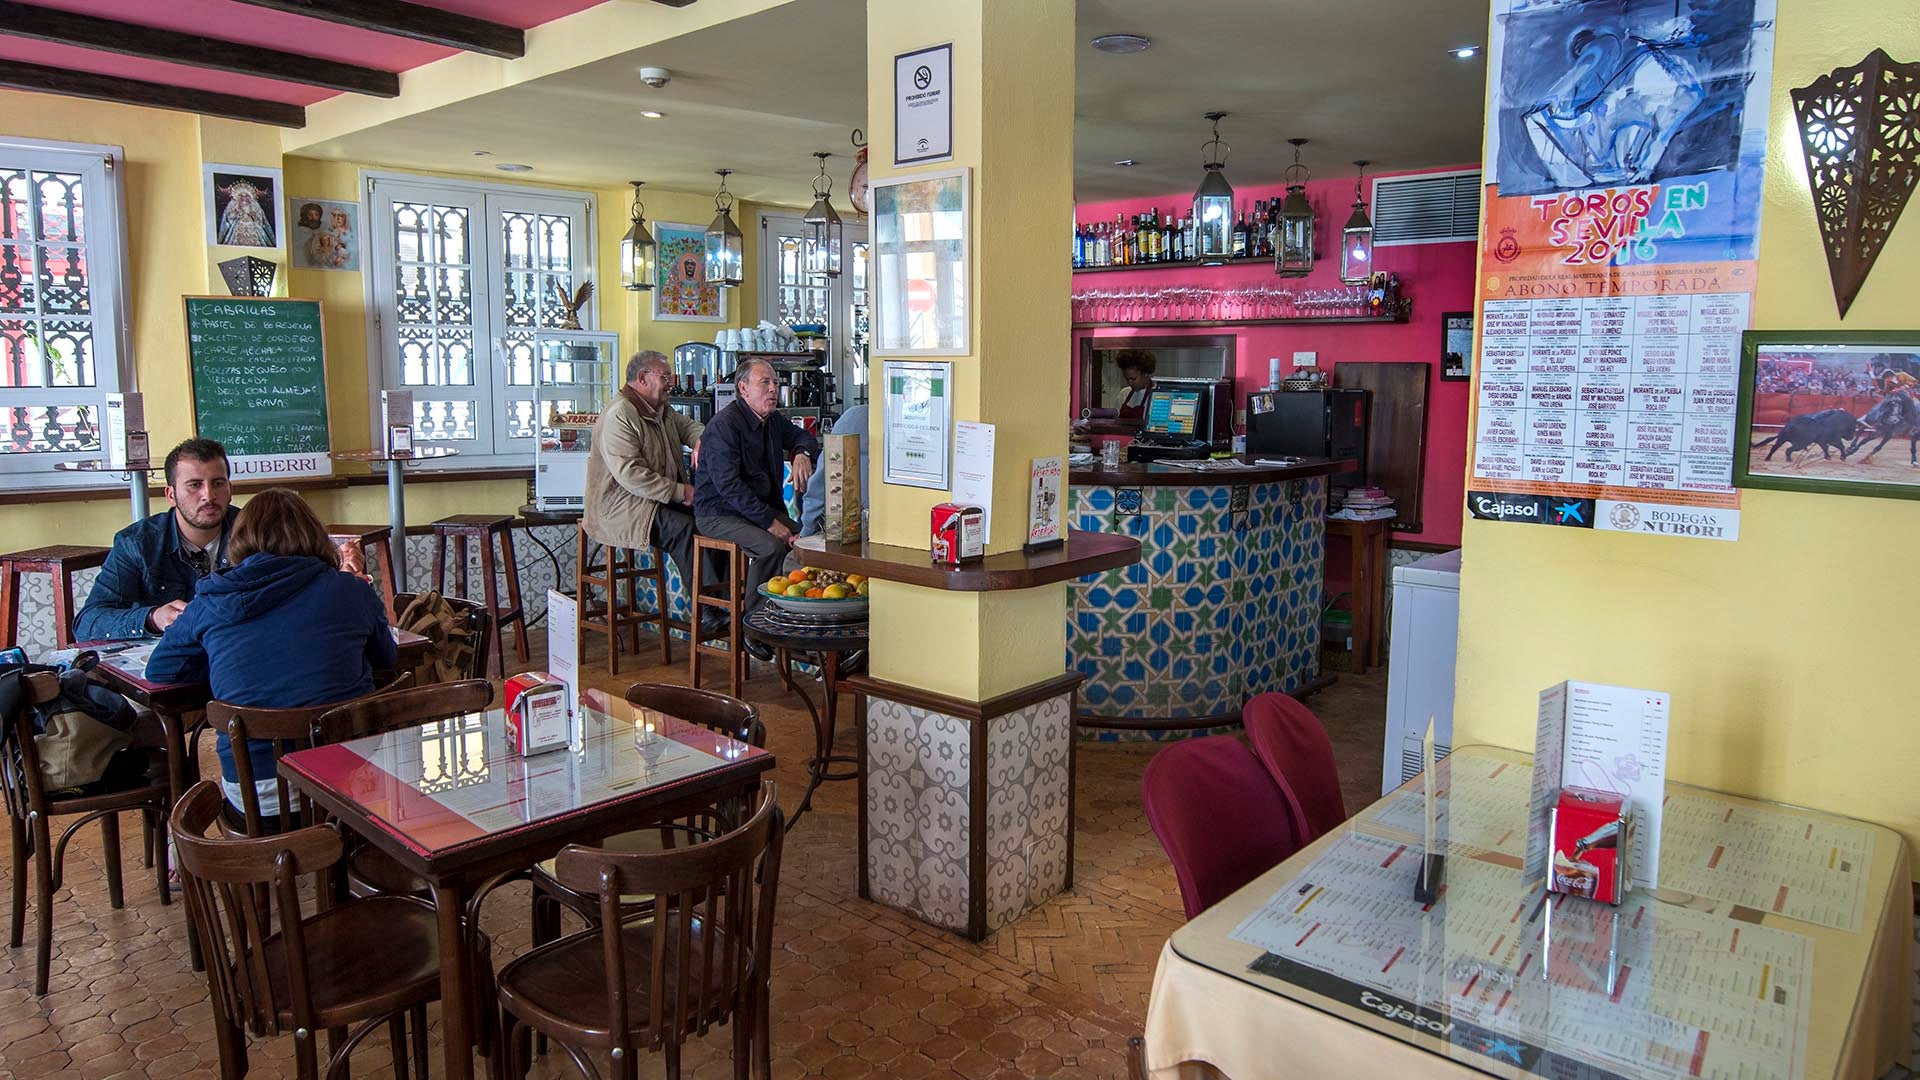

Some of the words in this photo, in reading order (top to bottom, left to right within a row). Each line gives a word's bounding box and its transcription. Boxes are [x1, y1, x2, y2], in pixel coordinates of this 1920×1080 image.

[1532, 189, 1652, 222] TOROS
[1666, 183, 1708, 210] EN
[1551, 210, 1685, 244] SEVILLA
[1564, 238, 1657, 265] 2016
[1504, 282, 1577, 296] ABONO
[1585, 277, 1722, 294] TEMPORADA
[233, 458, 318, 475] LUBERRI
[1476, 496, 1538, 518] Cajasol
[1651, 510, 1717, 526] BODEGAS
[1642, 520, 1724, 538] NUBORI
[1359, 990, 1455, 1036] Cajasol
